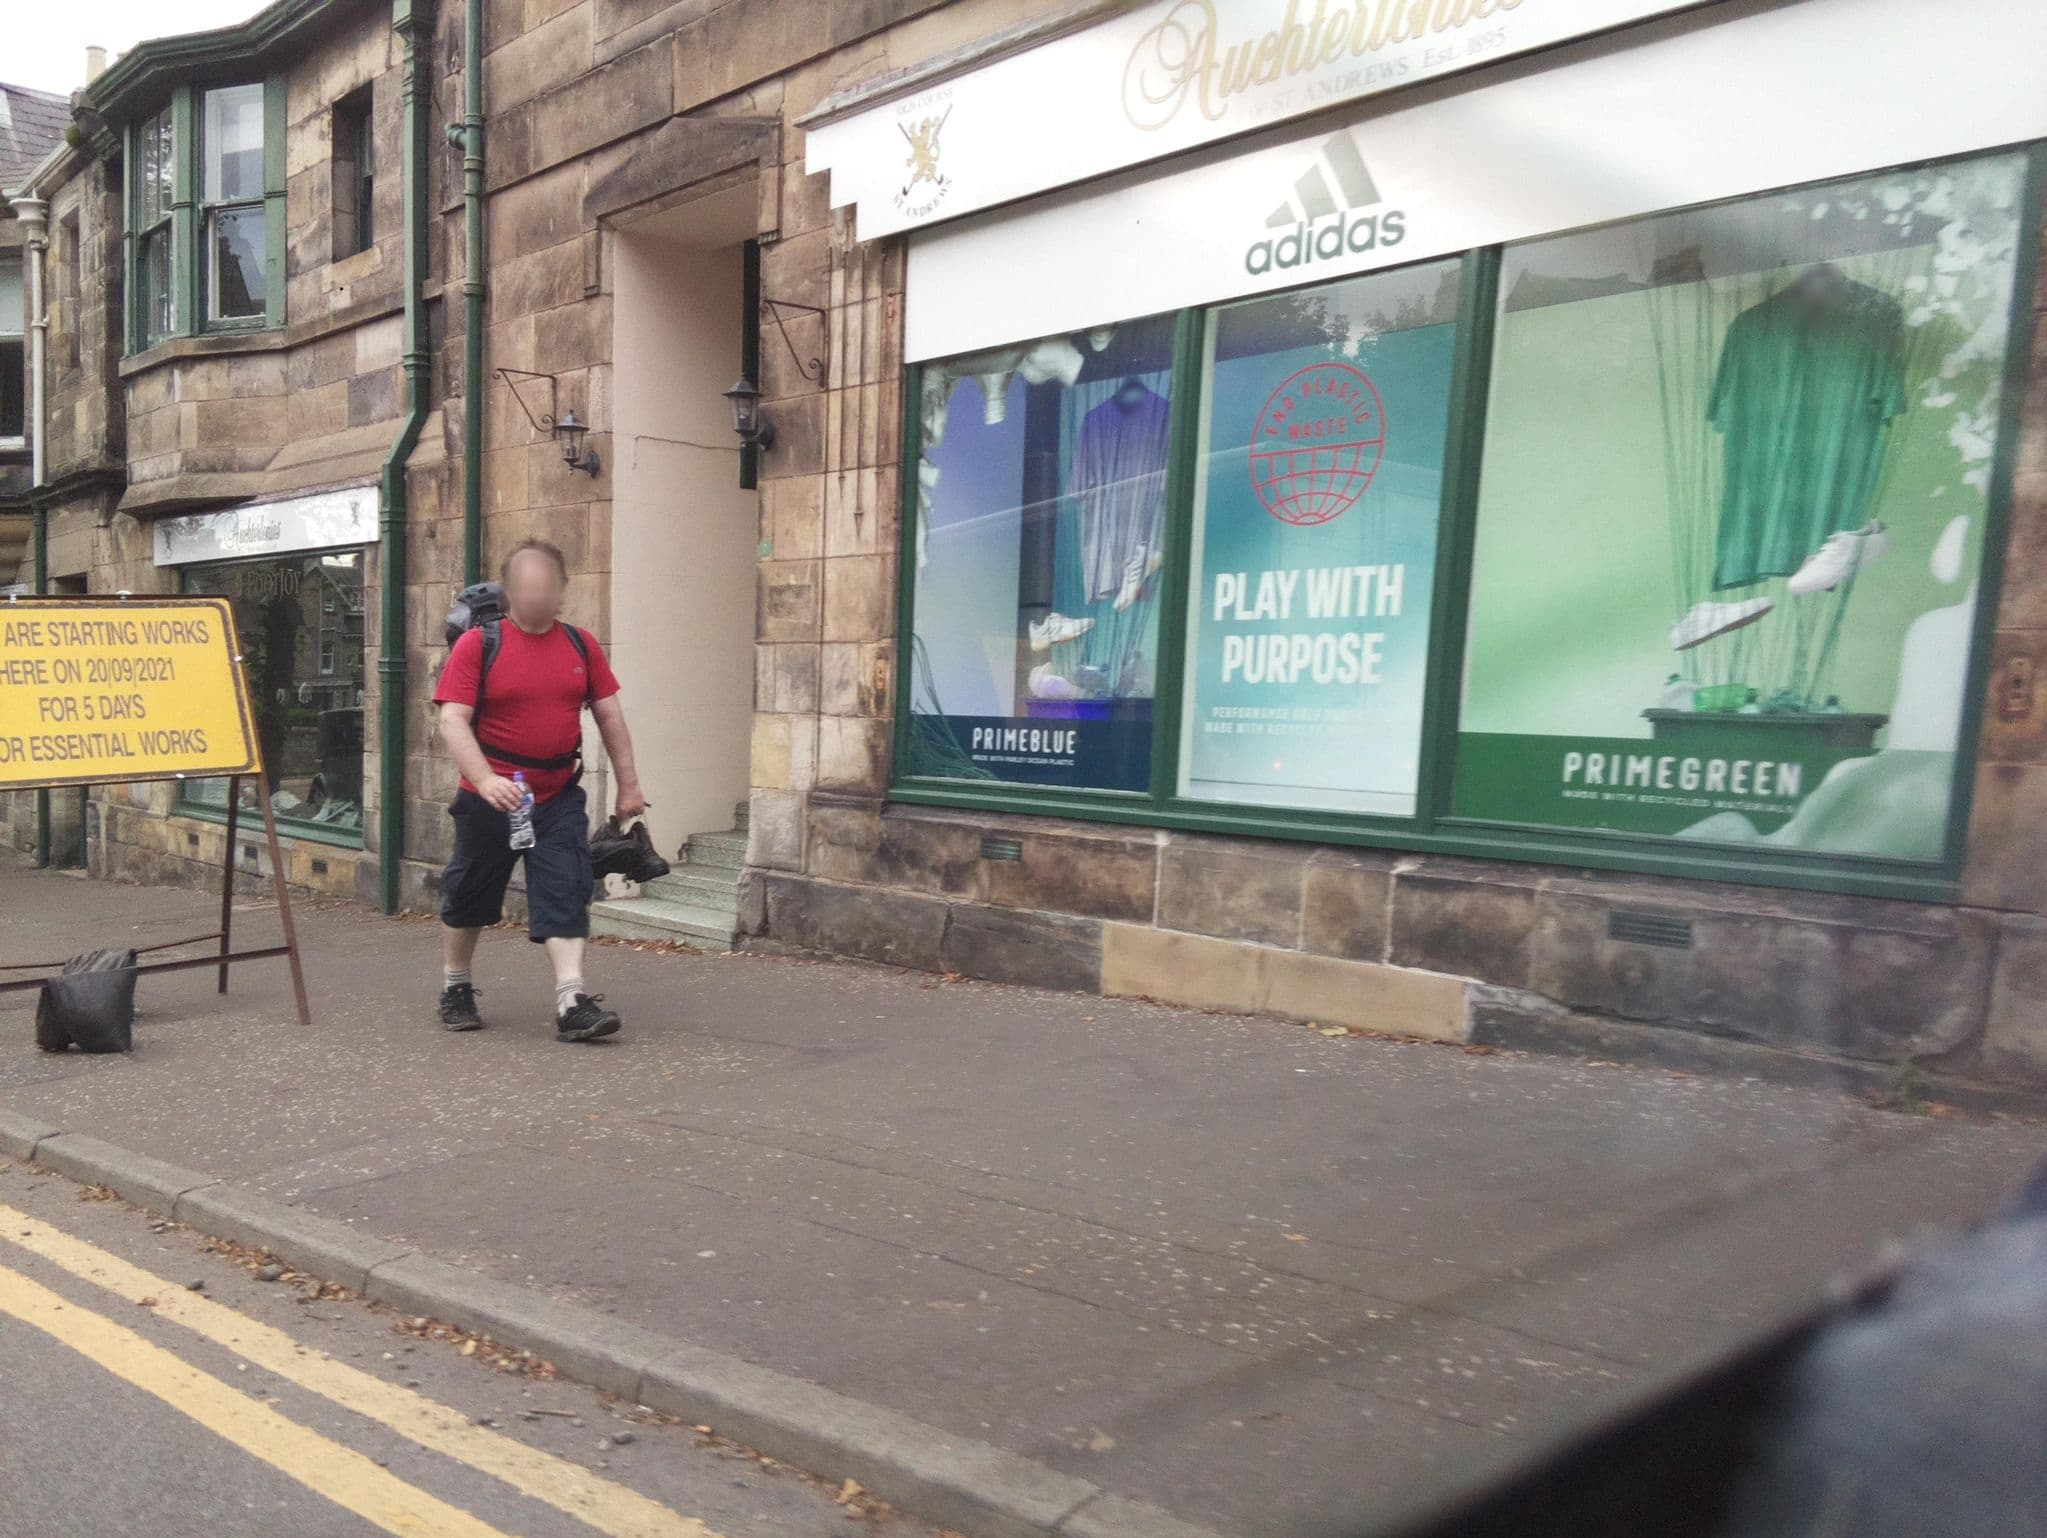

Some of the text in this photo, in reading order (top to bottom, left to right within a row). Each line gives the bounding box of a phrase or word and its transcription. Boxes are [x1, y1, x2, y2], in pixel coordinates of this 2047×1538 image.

[1122, 0, 1523, 131] Auchterloni
[1303, 57, 1410, 103] ANDREWS
[1245, 210, 1406, 276] adidas
[1264, 378, 1372, 436] END PLASTIC
[1287, 417, 1347, 440] WASTE
[1213, 564, 1405, 621] PLAY WITH
[4, 620, 210, 647] ARE STARTING WORKS
[0, 659, 49, 685] HERE
[53, 659, 82, 684] ON
[1222, 632, 1386, 685] PURPOSE
[38, 693, 146, 723] FOR 5 DAYS
[0, 728, 208, 763] OR ESSENTIAL WORKS
[972, 727, 1077, 754] PRIMEBLUE
[1562, 751, 1803, 798] PRIMEGREEN
